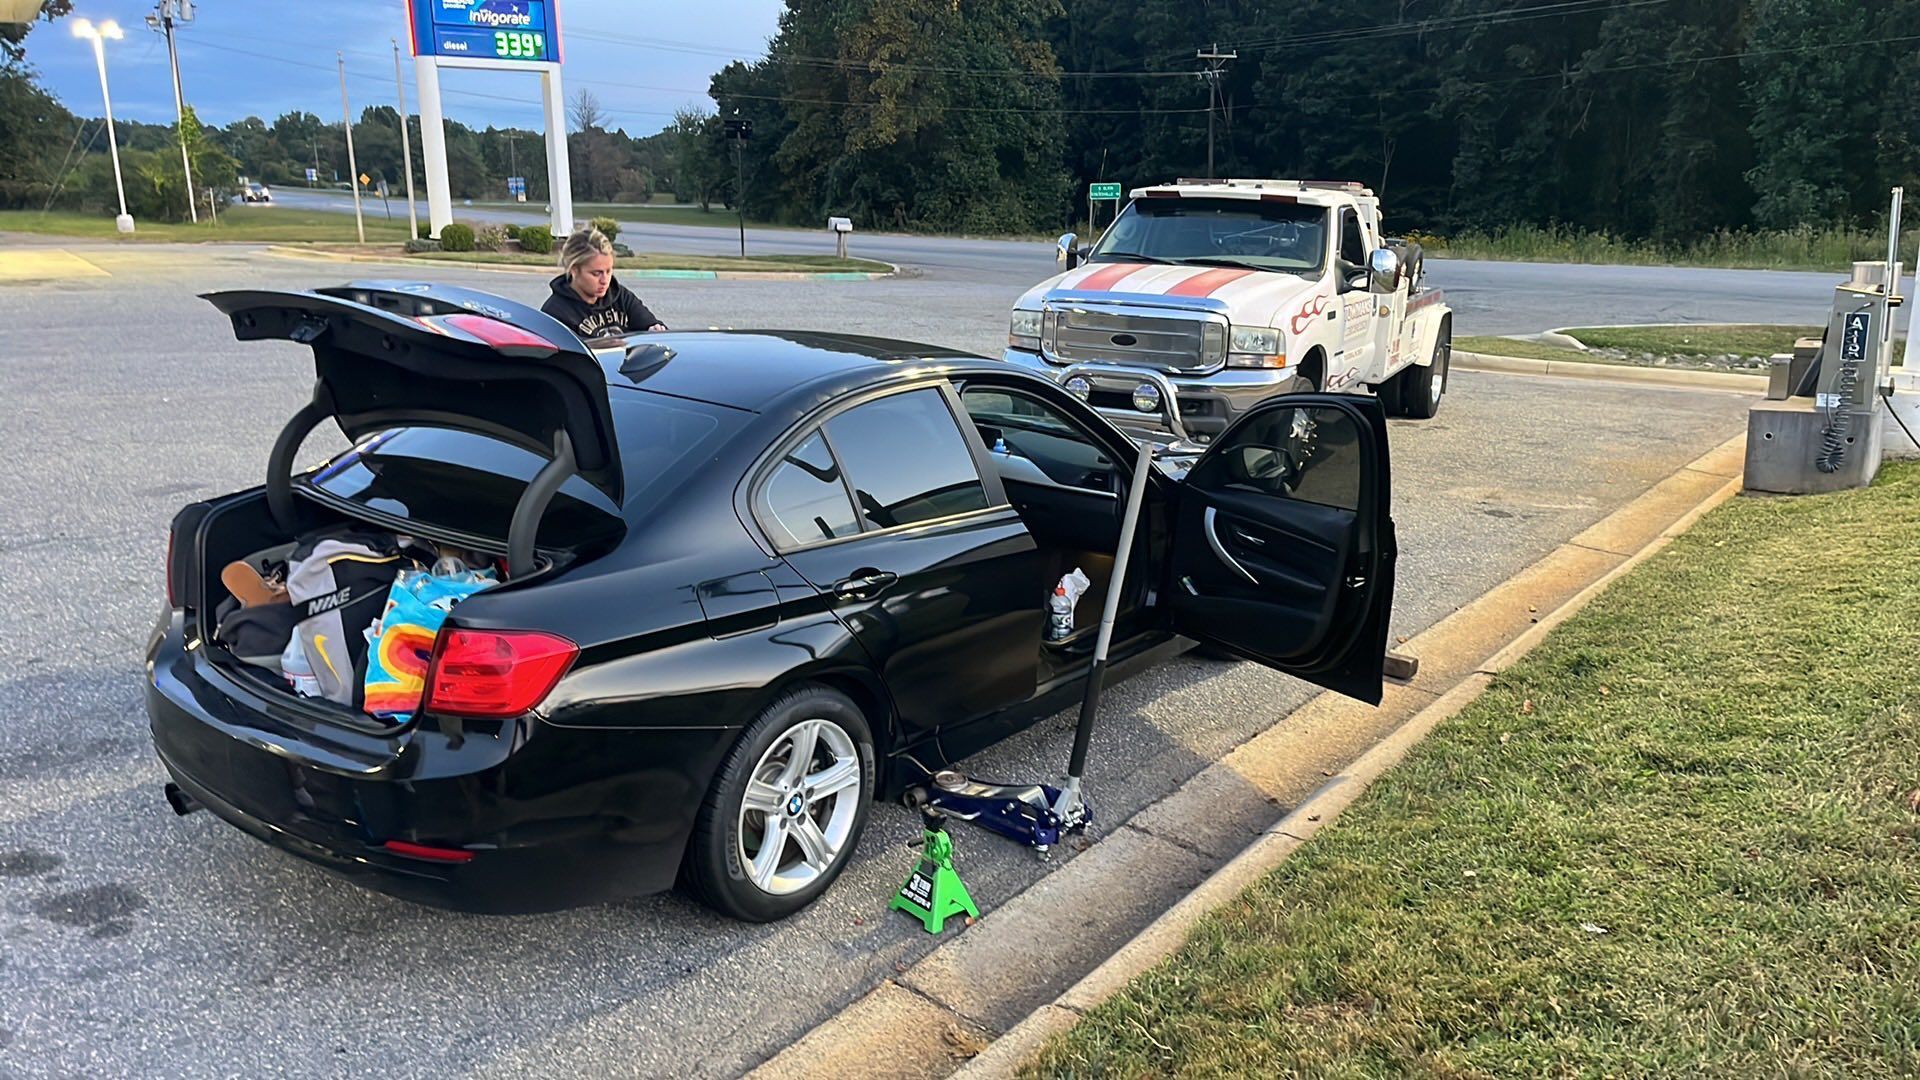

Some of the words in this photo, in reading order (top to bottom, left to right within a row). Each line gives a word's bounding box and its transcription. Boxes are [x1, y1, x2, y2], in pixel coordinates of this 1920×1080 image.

[469, 9, 531, 26] Invigorate
[443, 41, 468, 51] diesel
[308, 586, 352, 616] NIKE
[909, 873, 921, 892] 3
